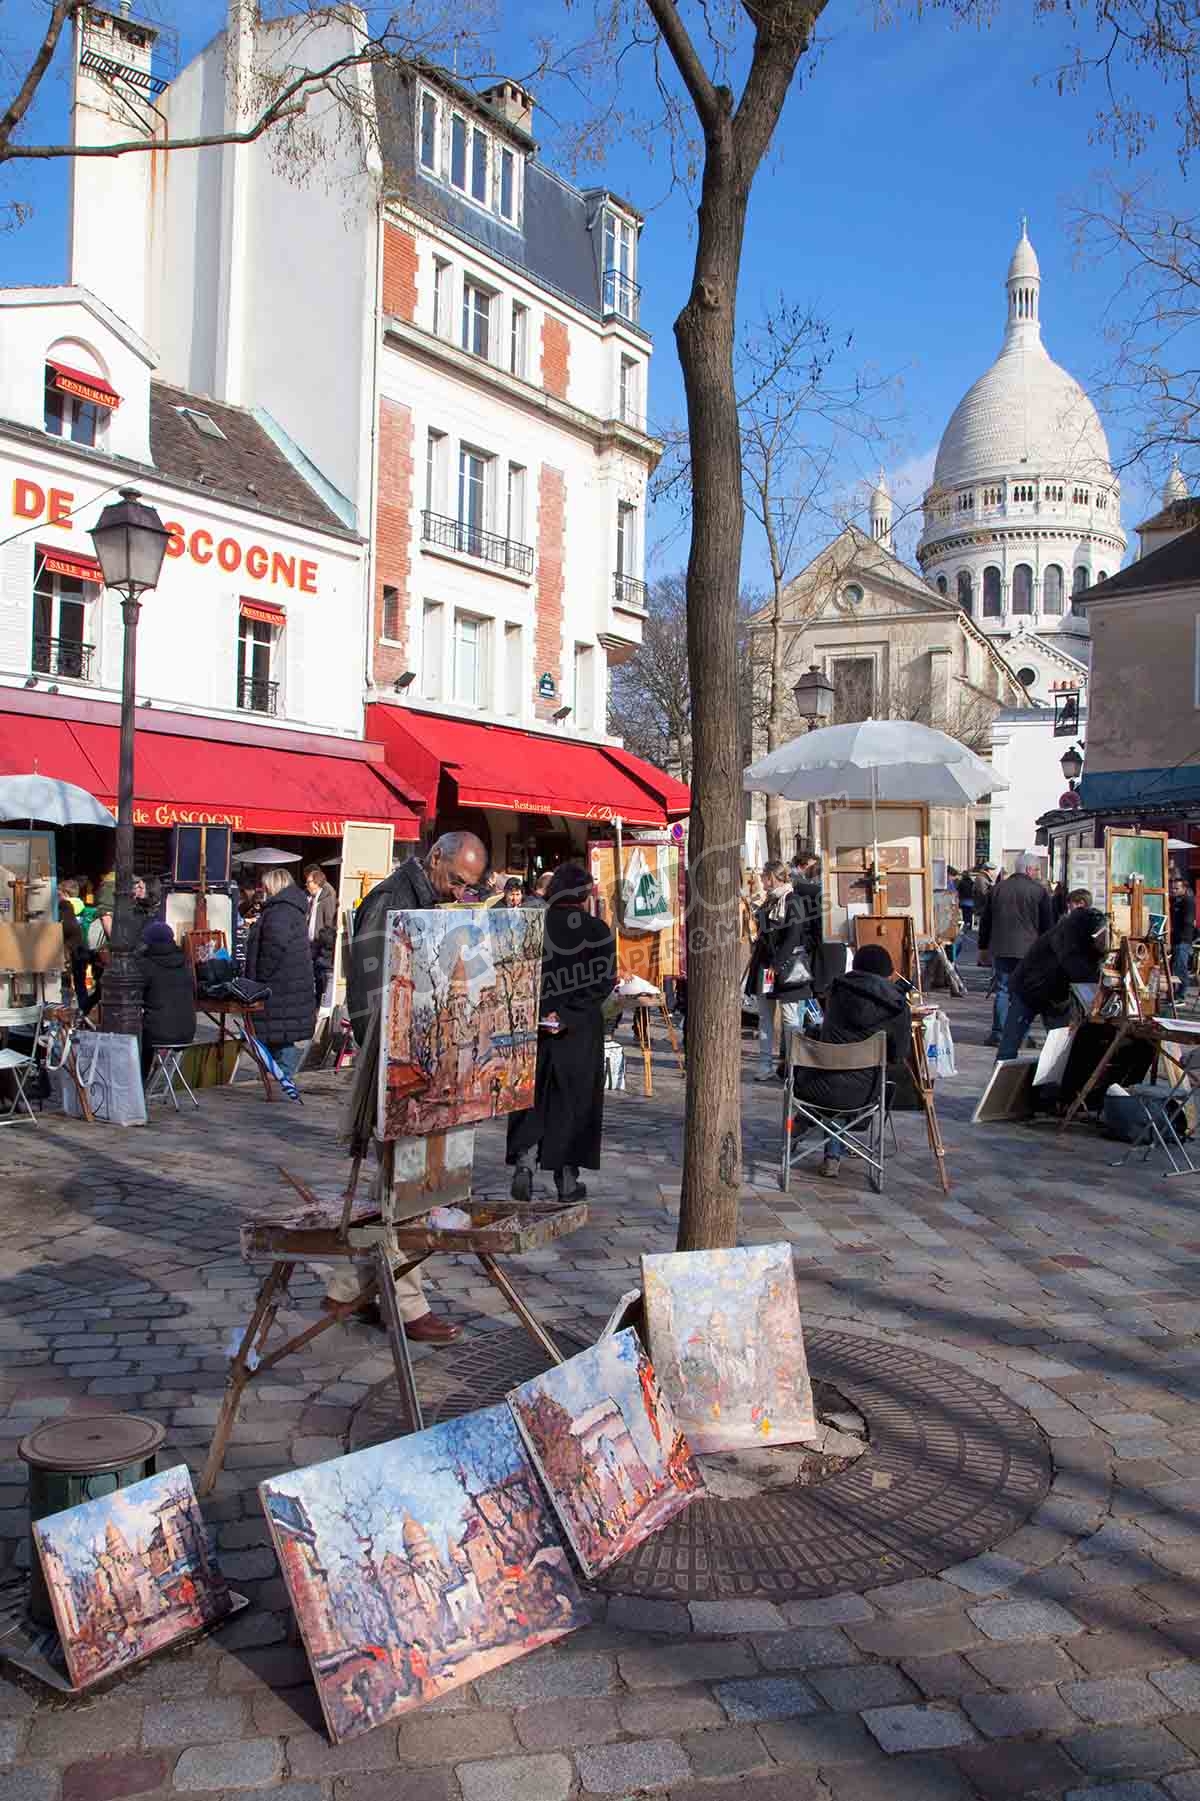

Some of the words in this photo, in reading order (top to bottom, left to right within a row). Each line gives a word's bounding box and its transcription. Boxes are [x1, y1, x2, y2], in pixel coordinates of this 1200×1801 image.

[61, 376, 116, 405] RESTAURANT
[12, 477, 75, 529] DE
[164, 521, 320, 593] SCOGNE
[50, 559, 78, 574] SALLE
[133, 808, 149, 824] de
[155, 803, 244, 830] GASCOGNE
[513, 799, 552, 813] Restaurant
